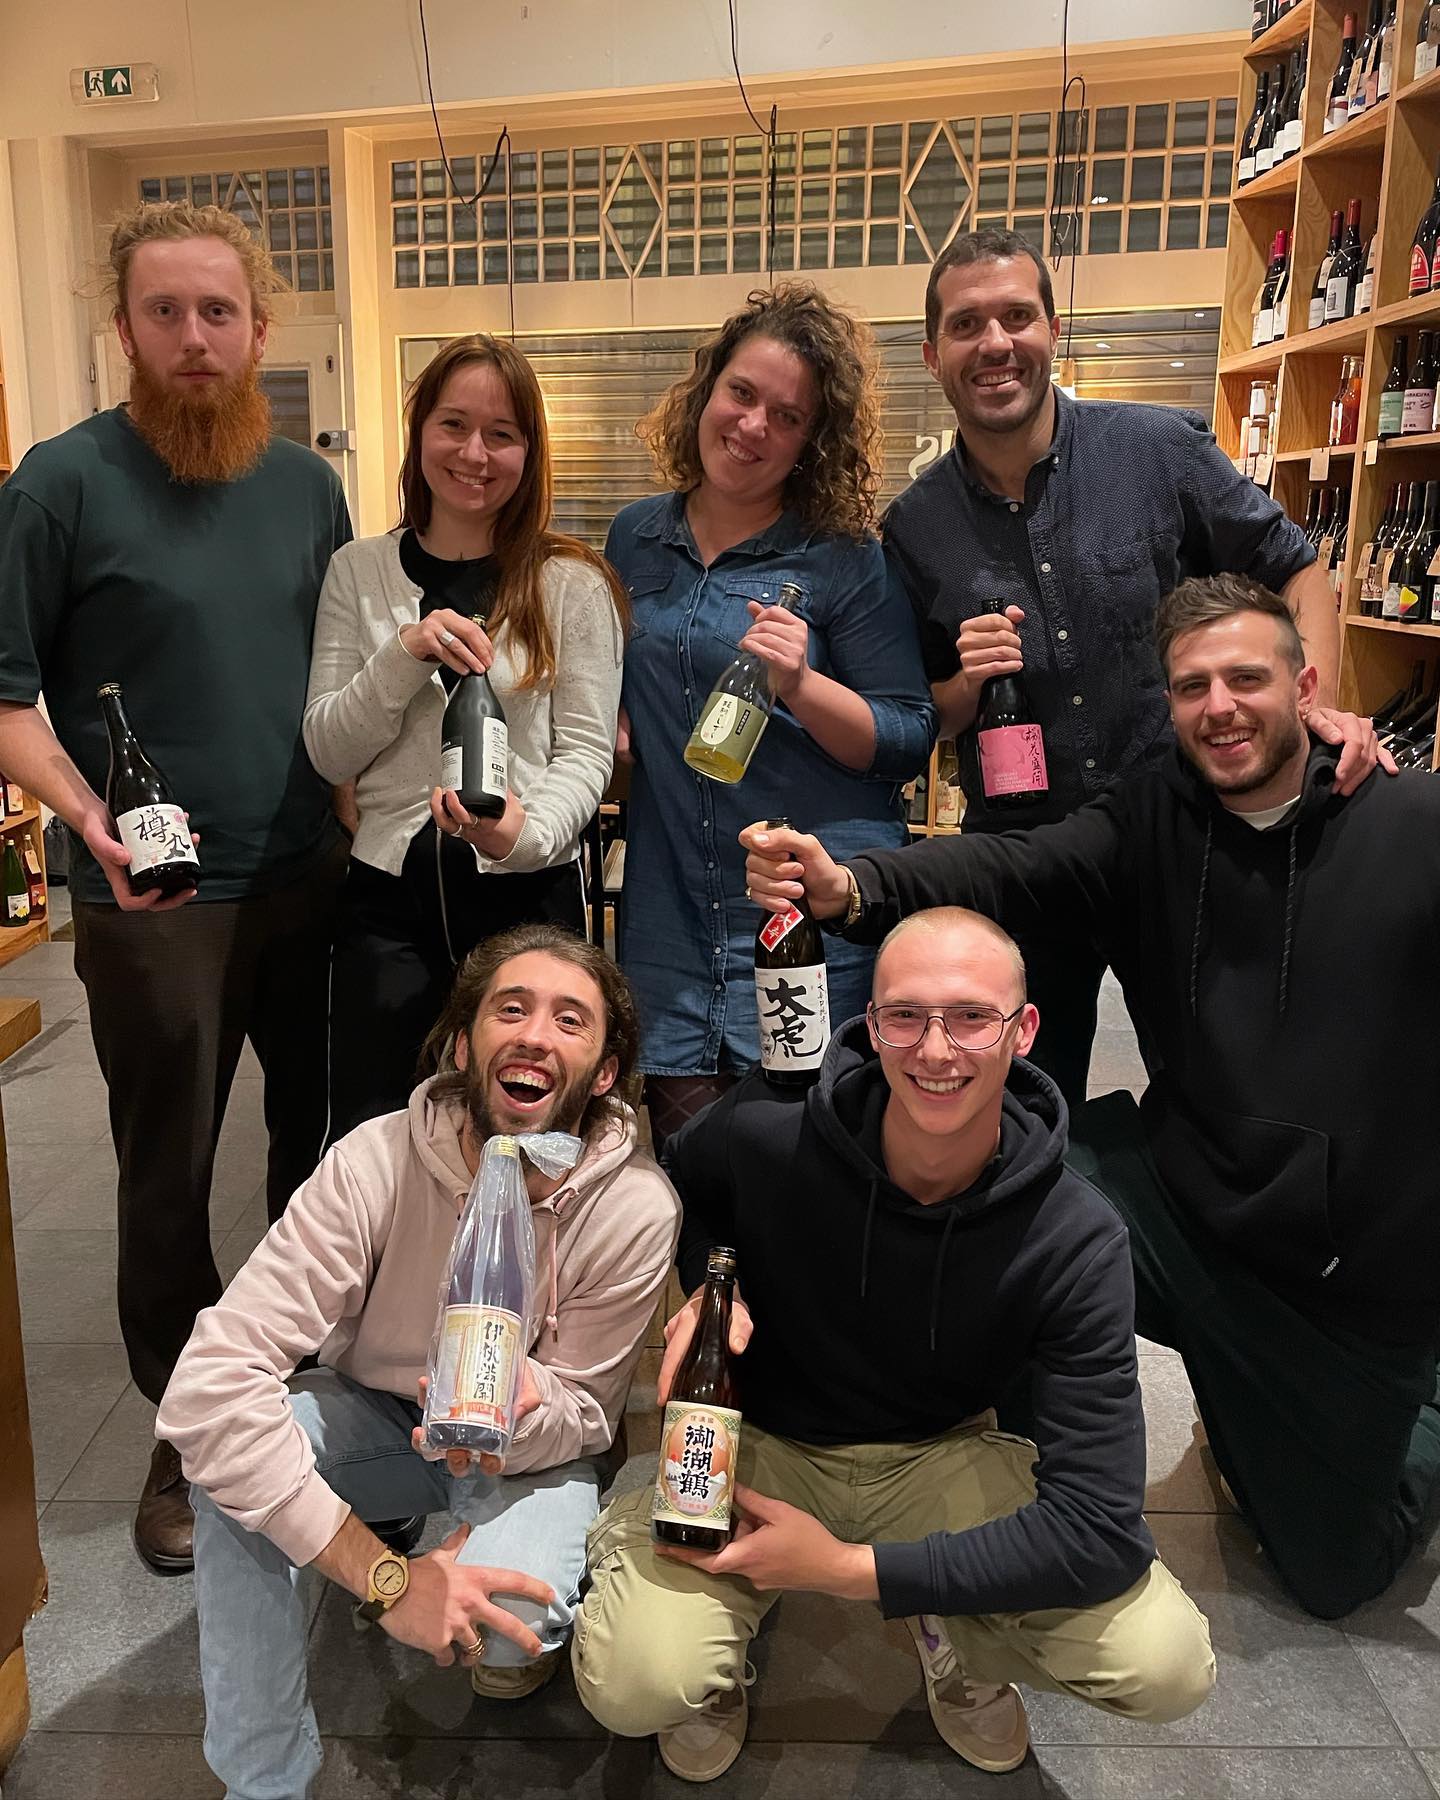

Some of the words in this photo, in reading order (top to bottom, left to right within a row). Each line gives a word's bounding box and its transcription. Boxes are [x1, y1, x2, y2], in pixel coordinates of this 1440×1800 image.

[763, 977, 824, 1058] 大虎
[679, 1425, 715, 1499] 御湖鶴
